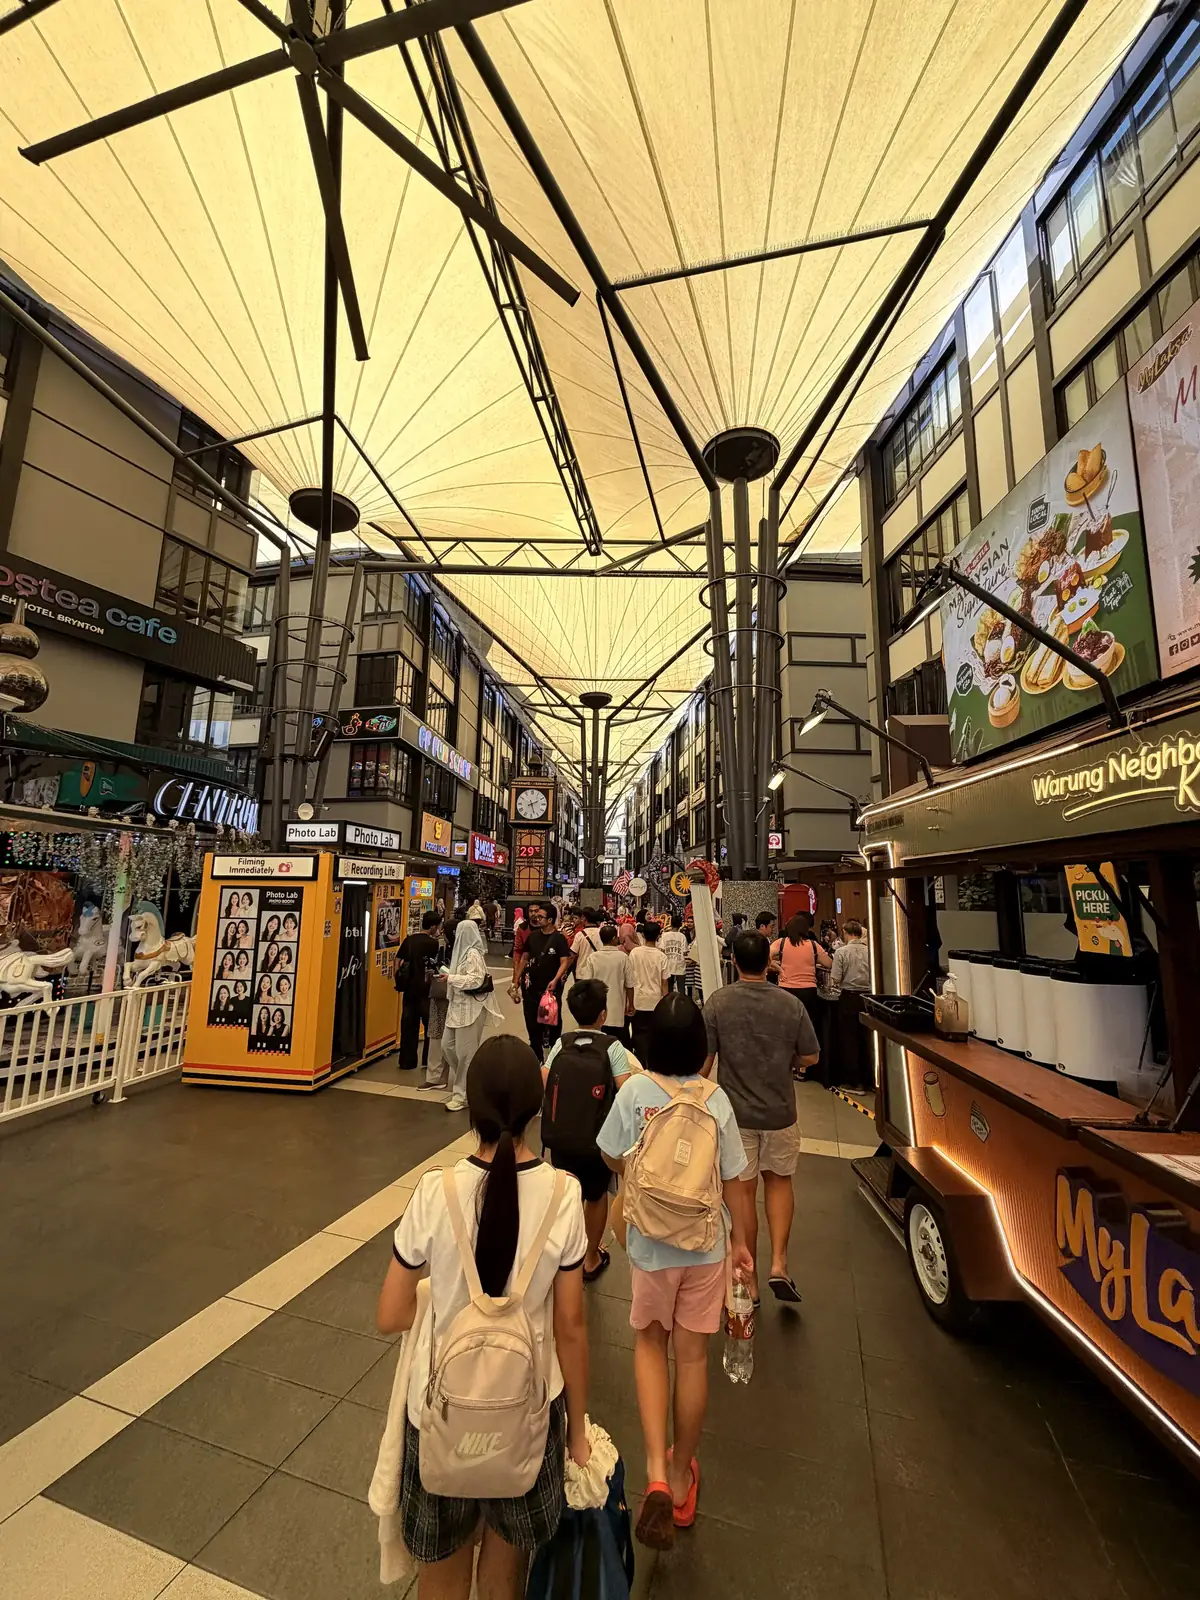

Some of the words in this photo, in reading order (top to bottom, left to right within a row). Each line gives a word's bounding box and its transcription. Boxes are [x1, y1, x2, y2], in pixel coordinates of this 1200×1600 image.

[948, 537, 1010, 613] MALYSIAN
[957, 549, 1013, 629] Signture!
[57, 613, 105, 636] BRYNTON
[105, 607, 178, 645] cafe
[432, 735, 449, 764] FUN
[449, 750, 472, 781] SCAPE
[1033, 766, 1104, 800] Warung
[288, 827, 316, 838] Photo
[319, 827, 337, 838] Lab
[354, 827, 379, 845] Photo
[380, 832, 394, 847] Lab
[229, 866, 275, 875] Immediately
[237, 857, 265, 867] Filming
[351, 863, 384, 878] Recording
[384, 865, 396, 877] Life
[266, 891, 285, 899] Photo
[286, 891, 299, 899] Lab
[1082, 902, 1111, 914] HERE
[457, 1431, 503, 1457] NIKE
